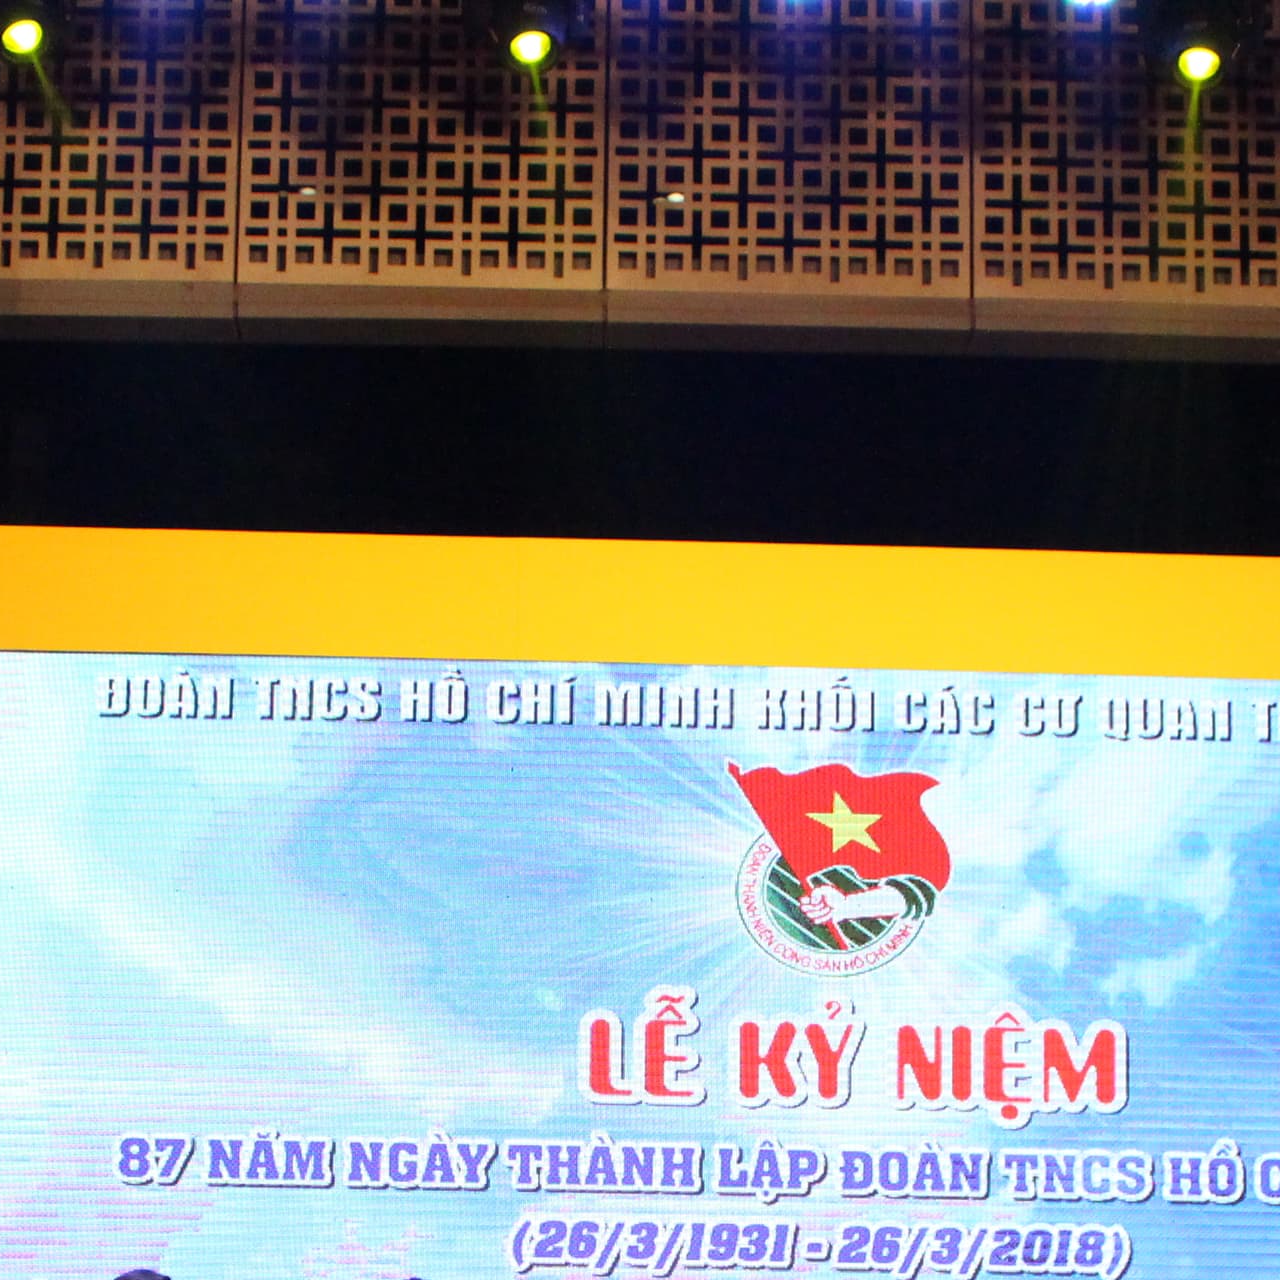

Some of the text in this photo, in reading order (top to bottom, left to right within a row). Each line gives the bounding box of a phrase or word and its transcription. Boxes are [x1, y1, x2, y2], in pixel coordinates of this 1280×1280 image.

[255, 676, 384, 723] TNCS
[487, 675, 578, 726] CHÍ
[595, 681, 736, 730] MINH
[756, 675, 876, 733] KHỐI
[894, 685, 996, 736] CÁC
[1101, 696, 1233, 742] QUAN
[586, 992, 1121, 1123] LỄ KỶ NIỆM
[117, 1136, 189, 1180] 87
[206, 1131, 327, 1183] NĂM
[347, 1132, 490, 1185] NGÀY
[506, 1134, 698, 1190] THÀNH
[717, 1139, 821, 1199] LẬP
[838, 1141, 985, 1194] ĐOÀN
[1002, 1152, 1154, 1198] TNCS
[1167, 1141, 1240, 1200] HỒ
